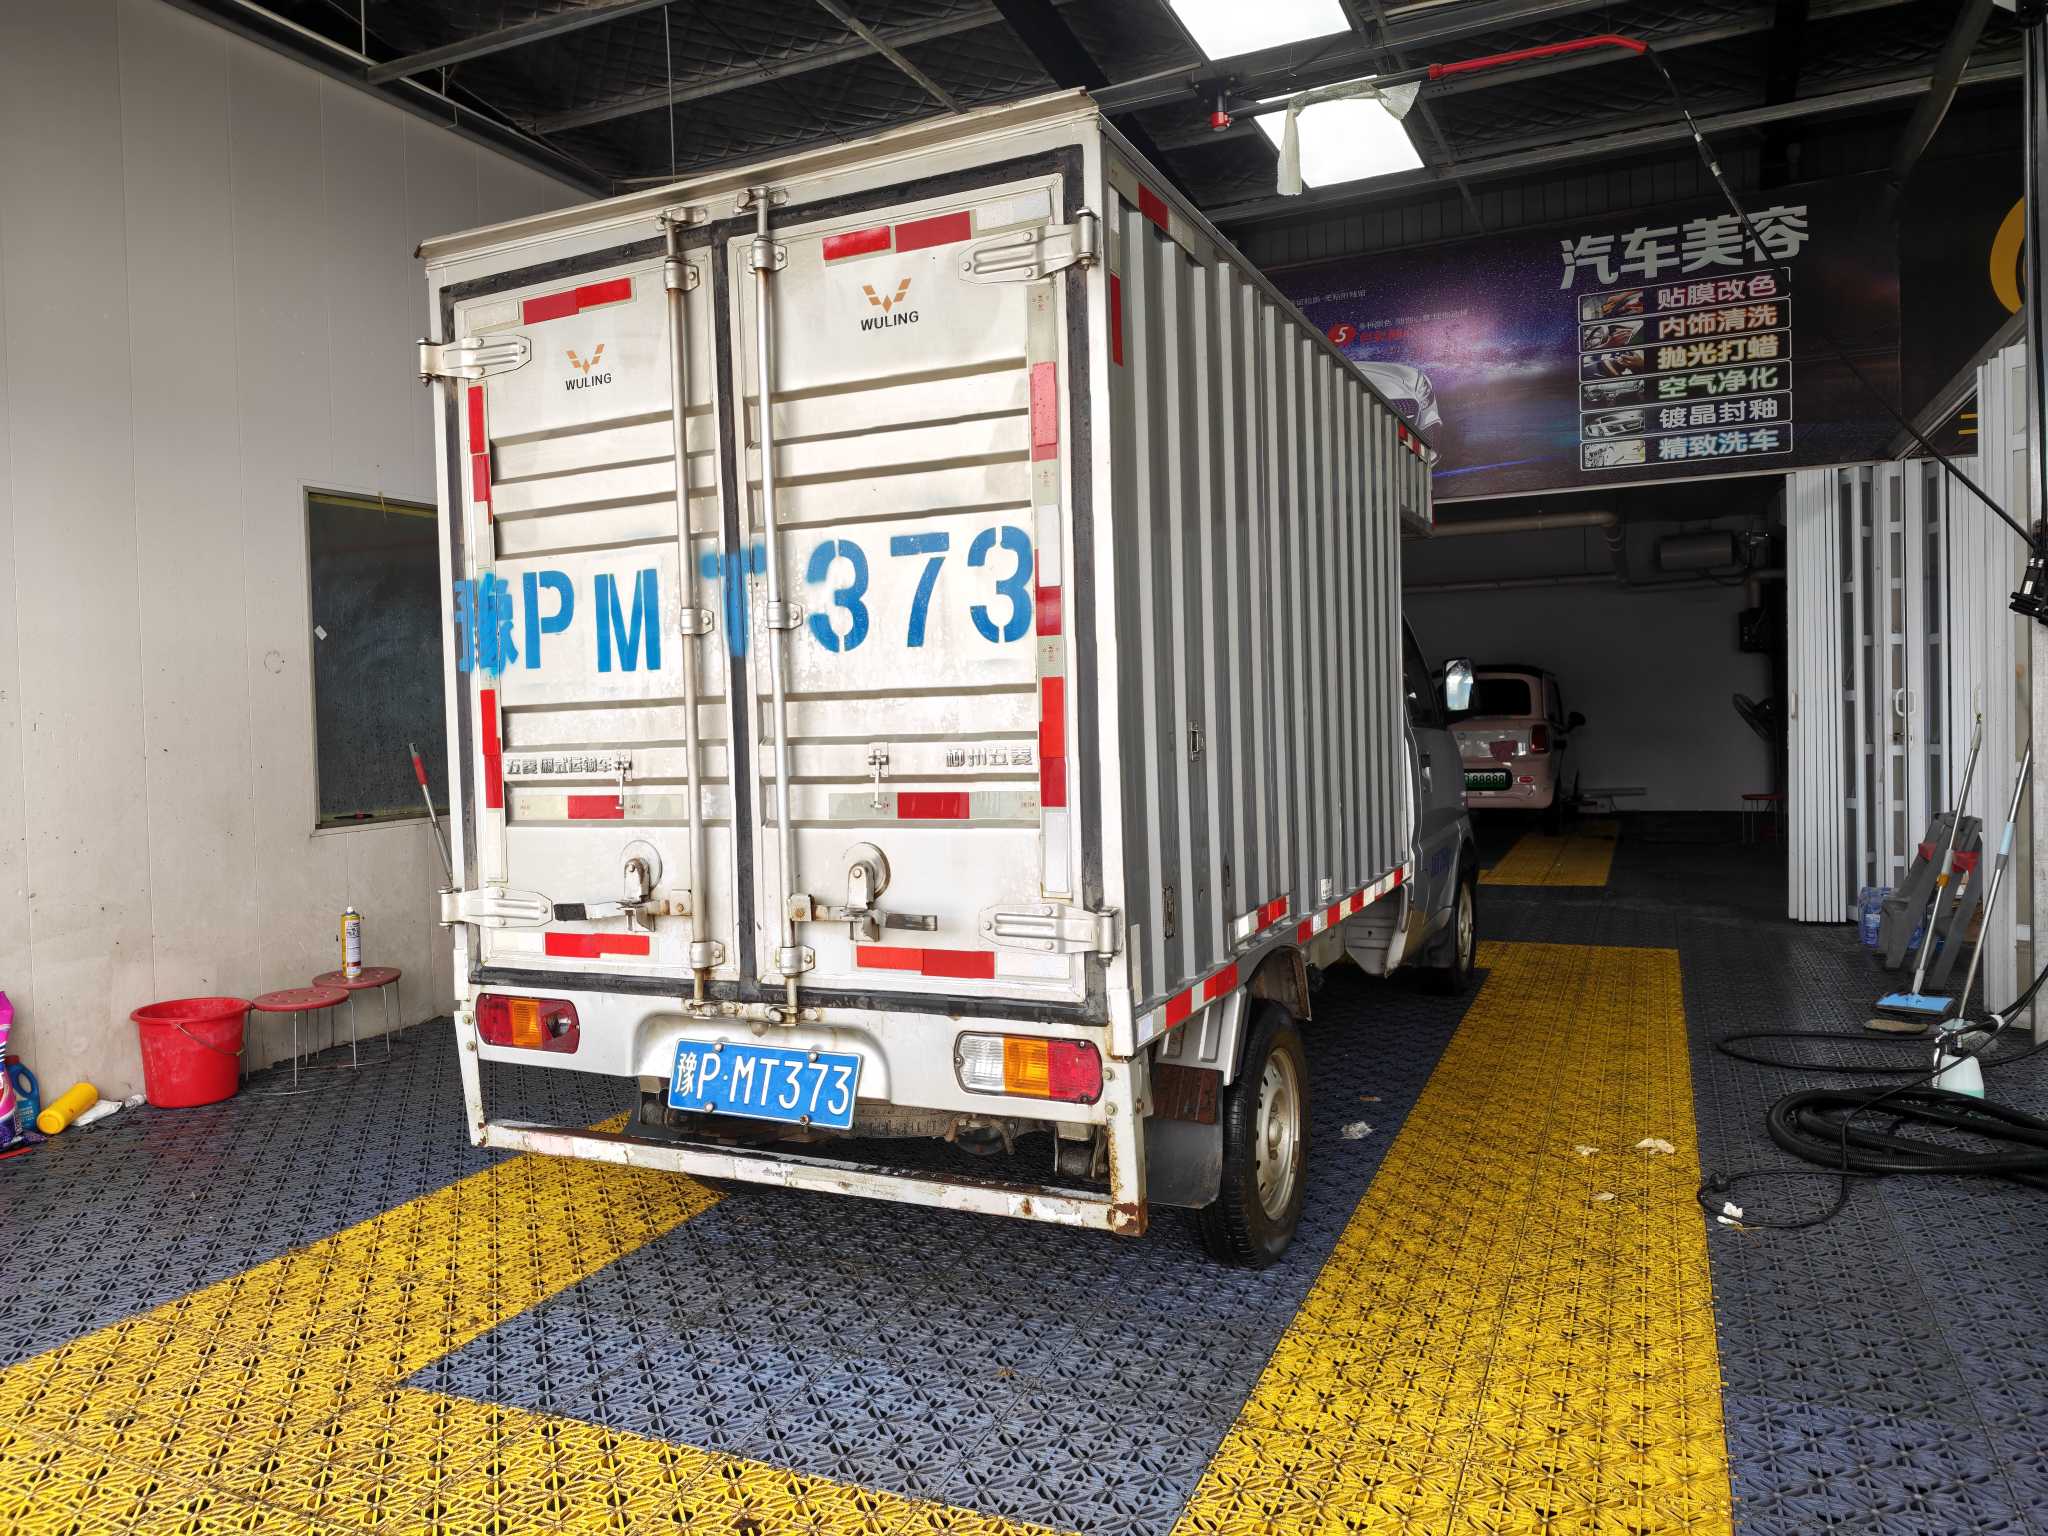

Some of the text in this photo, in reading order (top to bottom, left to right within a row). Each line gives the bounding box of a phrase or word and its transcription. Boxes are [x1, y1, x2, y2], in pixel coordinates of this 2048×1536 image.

[1560, 205, 1809, 290] 汽车美容
[1657, 275, 1777, 310] 贴膜改色
[860, 311, 919, 331] WULING
[1334, 326, 1349, 343] 5
[1658, 304, 1778, 339] 内饰清洗
[1657, 334, 1779, 370] 抛光打蜡
[565, 373, 612, 392] WULING
[1658, 367, 1779, 399] 空气净化
[1658, 398, 1778, 429] 镀晶封釉
[1657, 428, 1780, 460] 精致洗车
